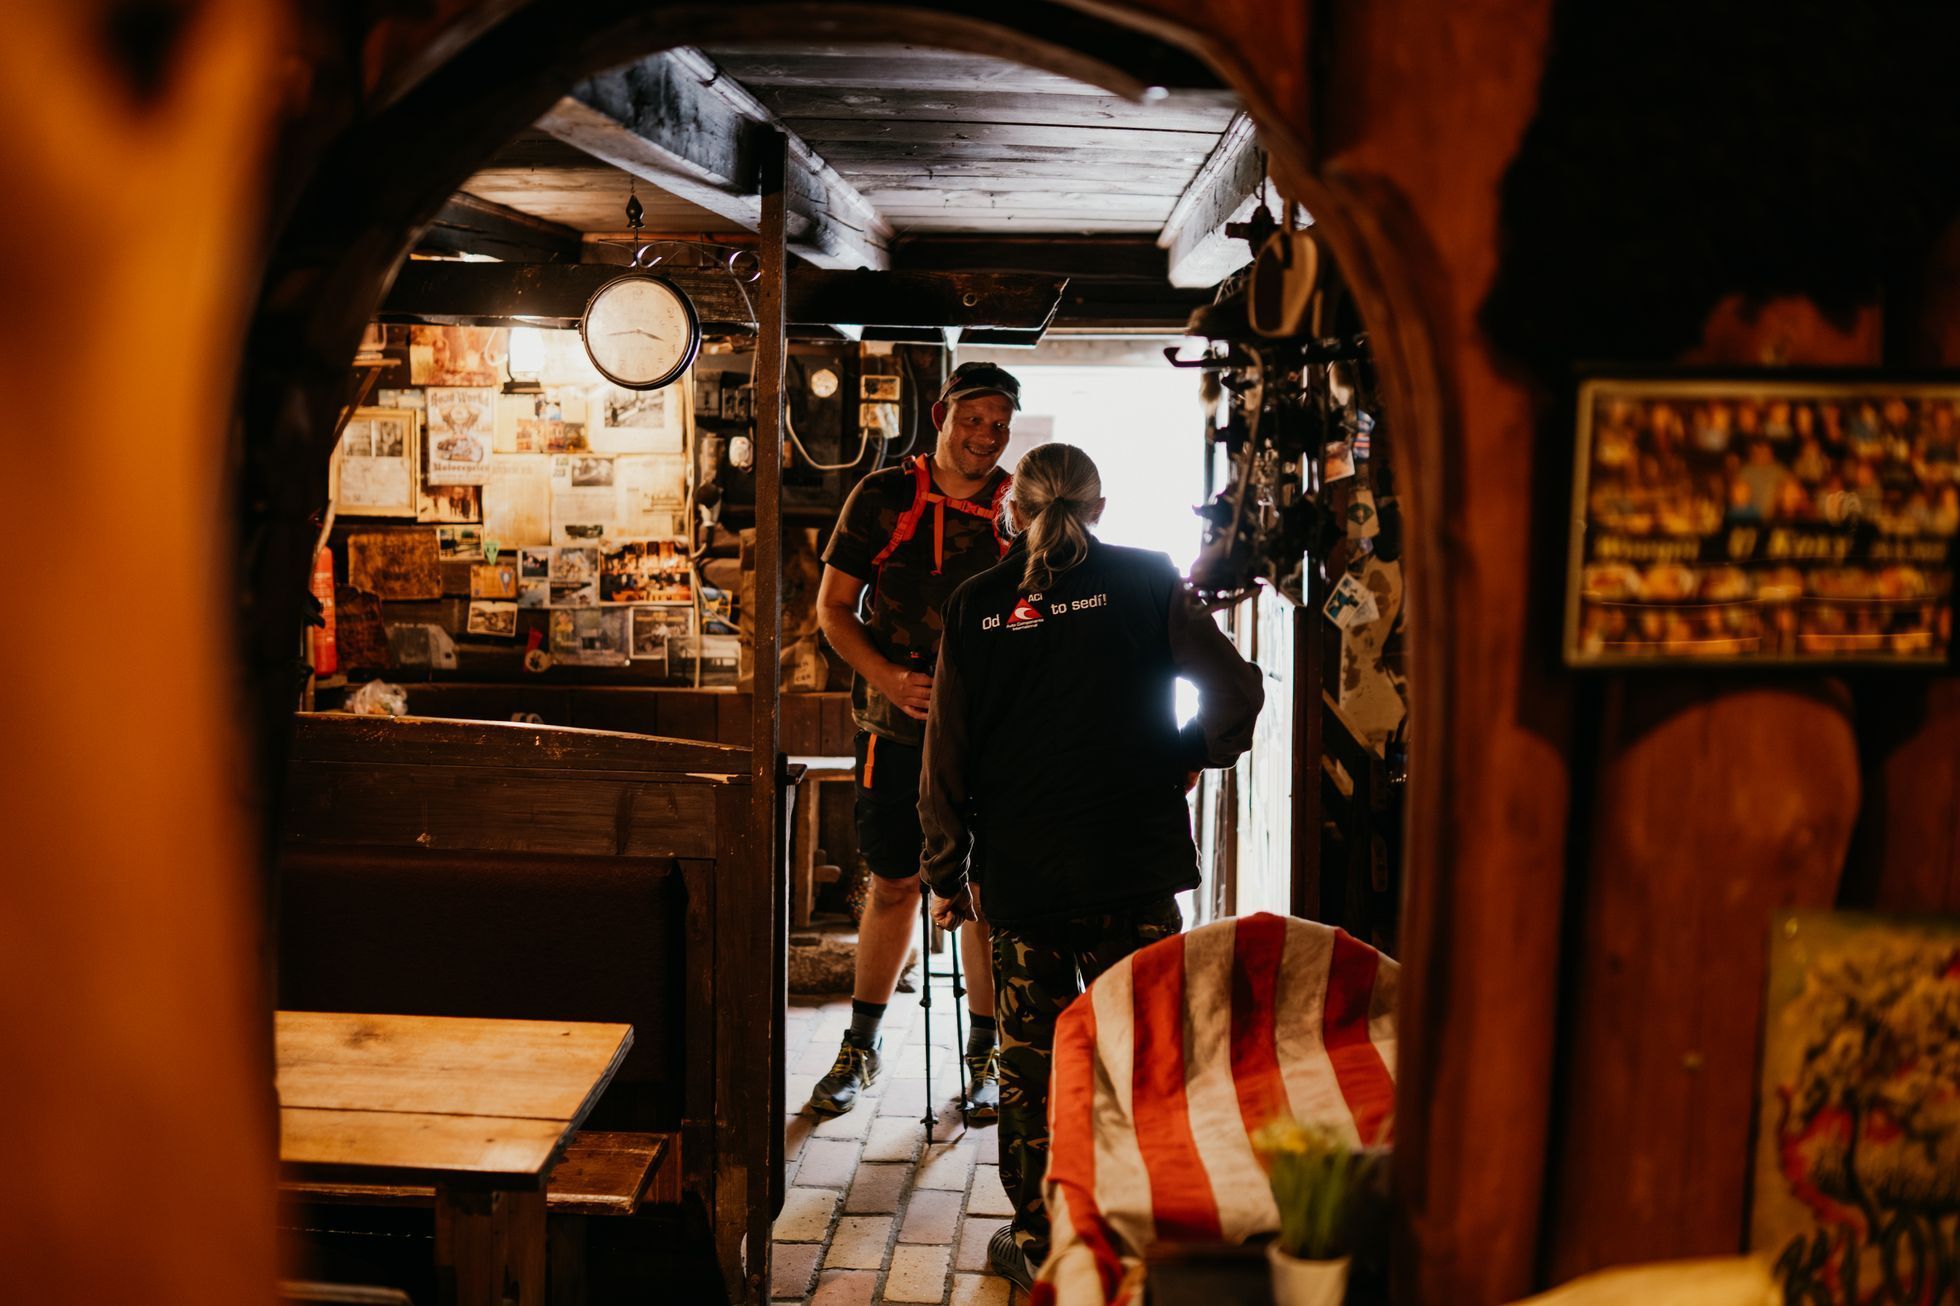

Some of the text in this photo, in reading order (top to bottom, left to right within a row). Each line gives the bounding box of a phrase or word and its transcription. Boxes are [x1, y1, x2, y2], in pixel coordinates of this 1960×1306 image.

[982, 593, 1107, 630] Od to sedí!
